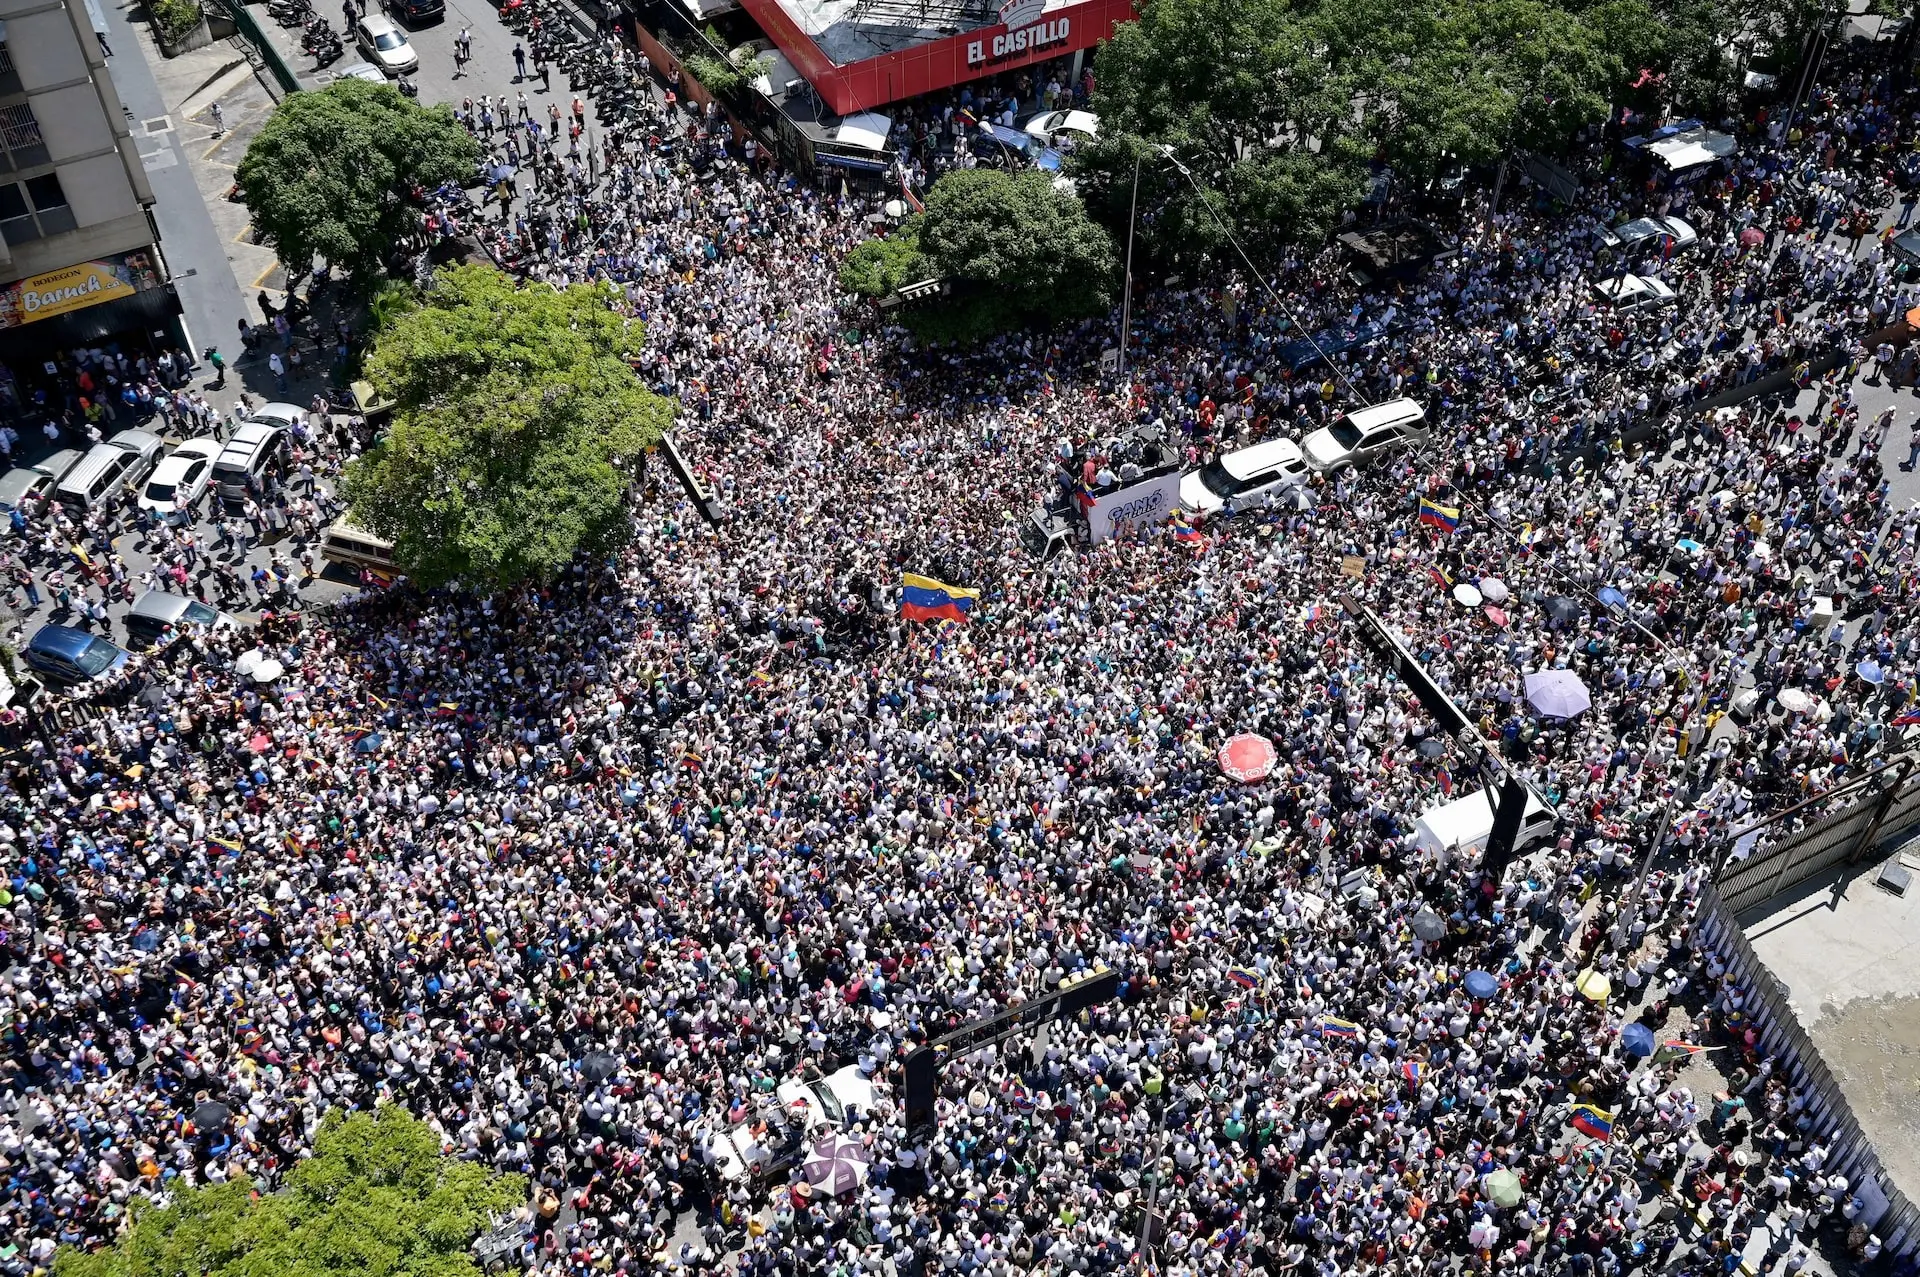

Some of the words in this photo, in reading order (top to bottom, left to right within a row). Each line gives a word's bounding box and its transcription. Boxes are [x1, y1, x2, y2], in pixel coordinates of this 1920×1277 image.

[967, 40, 986, 64] EL
[992, 17, 1070, 57] CASTILLO
[22, 274, 101, 312] Baruch
[32, 269, 81, 288] BODEGON
[1108, 489, 1163, 520] GANÓ
